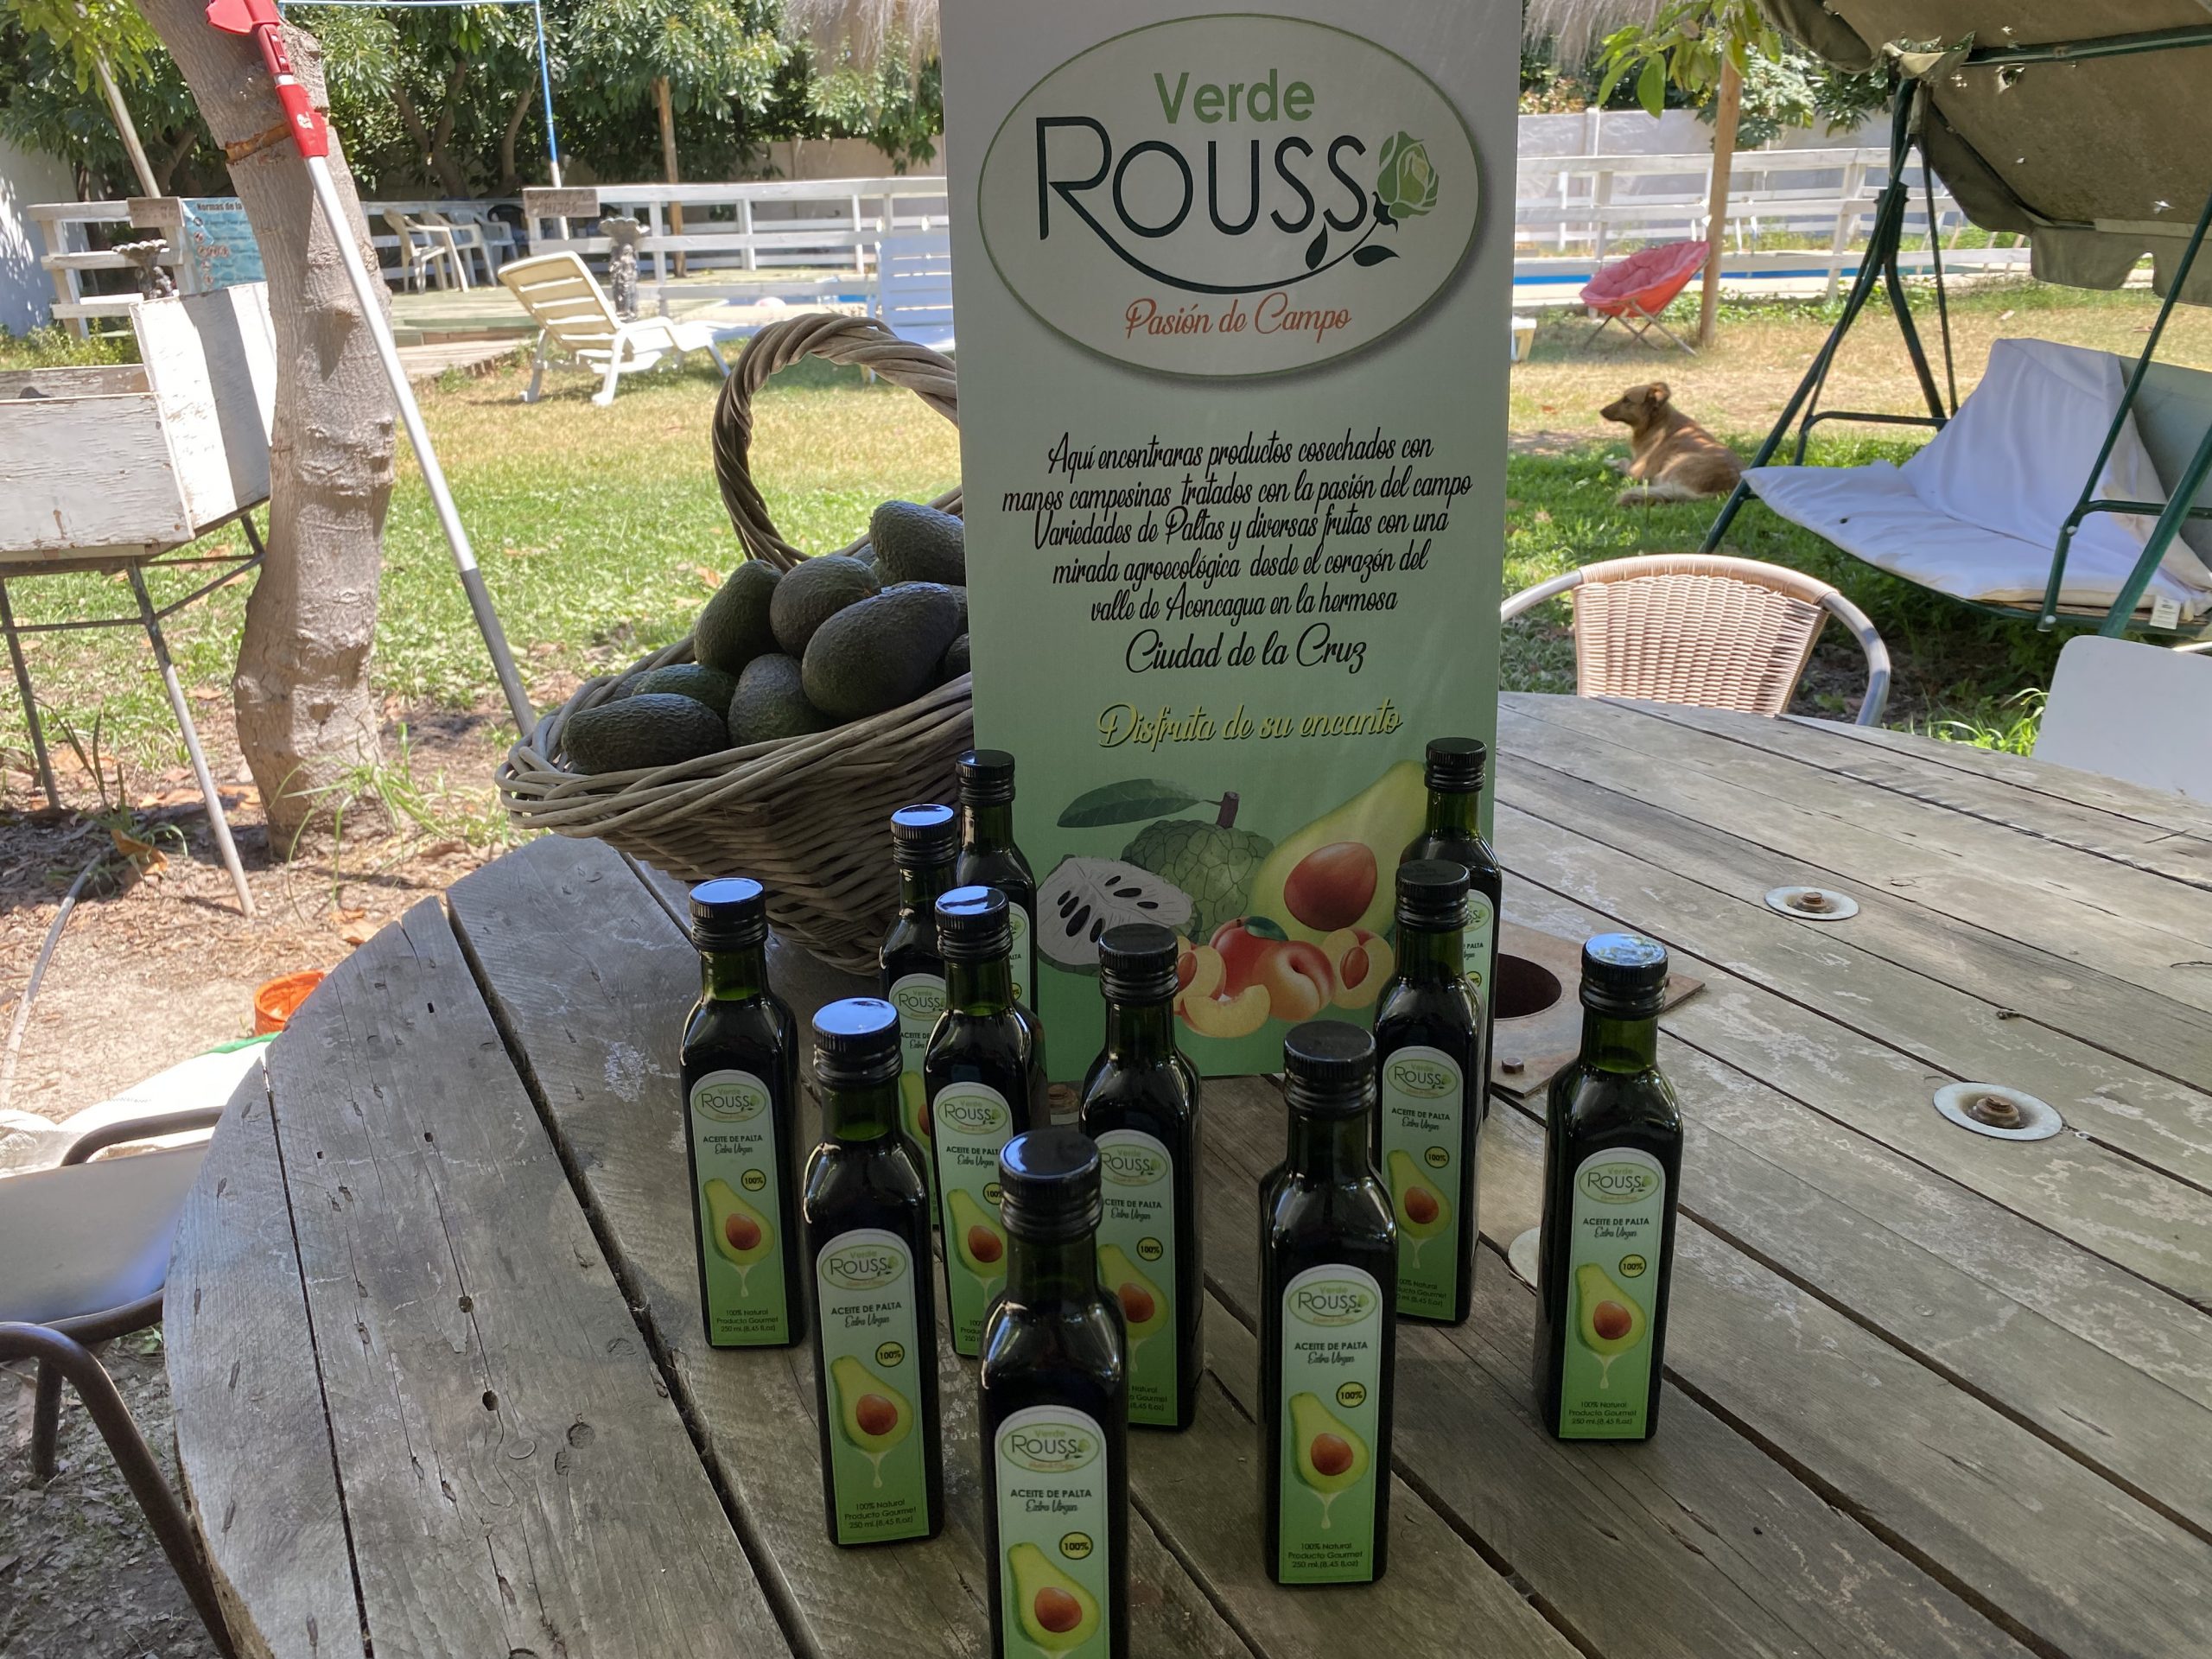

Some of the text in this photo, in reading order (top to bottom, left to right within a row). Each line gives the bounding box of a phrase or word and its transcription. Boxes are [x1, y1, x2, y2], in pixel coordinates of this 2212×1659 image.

[1154, 68, 1315, 124] Verde
[1036, 116, 1369, 295] ROUSS
[1125, 292, 1351, 343] Pasión de Campo
[1048, 427, 1433, 484] Aquí encontraras productos cosechados con
[1002, 465, 1472, 522] manos campesinas tratados con la pasión del campo
[1034, 503, 1449, 550] Variedades de Paltas y diversas frutas con una
[1052, 538, 1432, 592] mirada agroecológica desde el corazón del
[1091, 582, 1398, 626] valle de Aconcagua en la hermosa
[1126, 622, 1367, 674] Ciudad de la Cruz
[1097, 698, 1403, 752] Disfruta de su encanto
[1395, 1066, 1441, 1090] ROUSS
[702, 1094, 749, 1115] ROUSS
[944, 1103, 991, 1127] ROUSS
[1391, 1108, 1415, 1116] ACEITE
[1428, 1112, 1450, 1121] PALTA
[946, 1146, 969, 1154] ACEITE
[1428, 1154, 1446, 1162] 100%
[1100, 1152, 1151, 1178] ROUSS
[1587, 1172, 1642, 1196] ROUSS
[1104, 1198, 1125, 1207] CEITE
[1138, 1200, 1162, 1209] PALTA
[1141, 1245, 1160, 1254] 100%
[830, 1257, 887, 1281] ROUSS
[830, 1301, 902, 1315] ACEITE DE PALTA
[1298, 1292, 1357, 1317] ROUSS
[880, 1350, 901, 1360] 100%
[1294, 1342, 1325, 1351] ACEITE
[1341, 1341, 1368, 1350] PALTA
[1341, 1391, 1363, 1400] 100%
[1012, 1434, 1077, 1463] ROUSS
[1010, 1489, 1092, 1498] ACEITE DE PALTA
[1065, 1542, 1089, 1551] 100%
